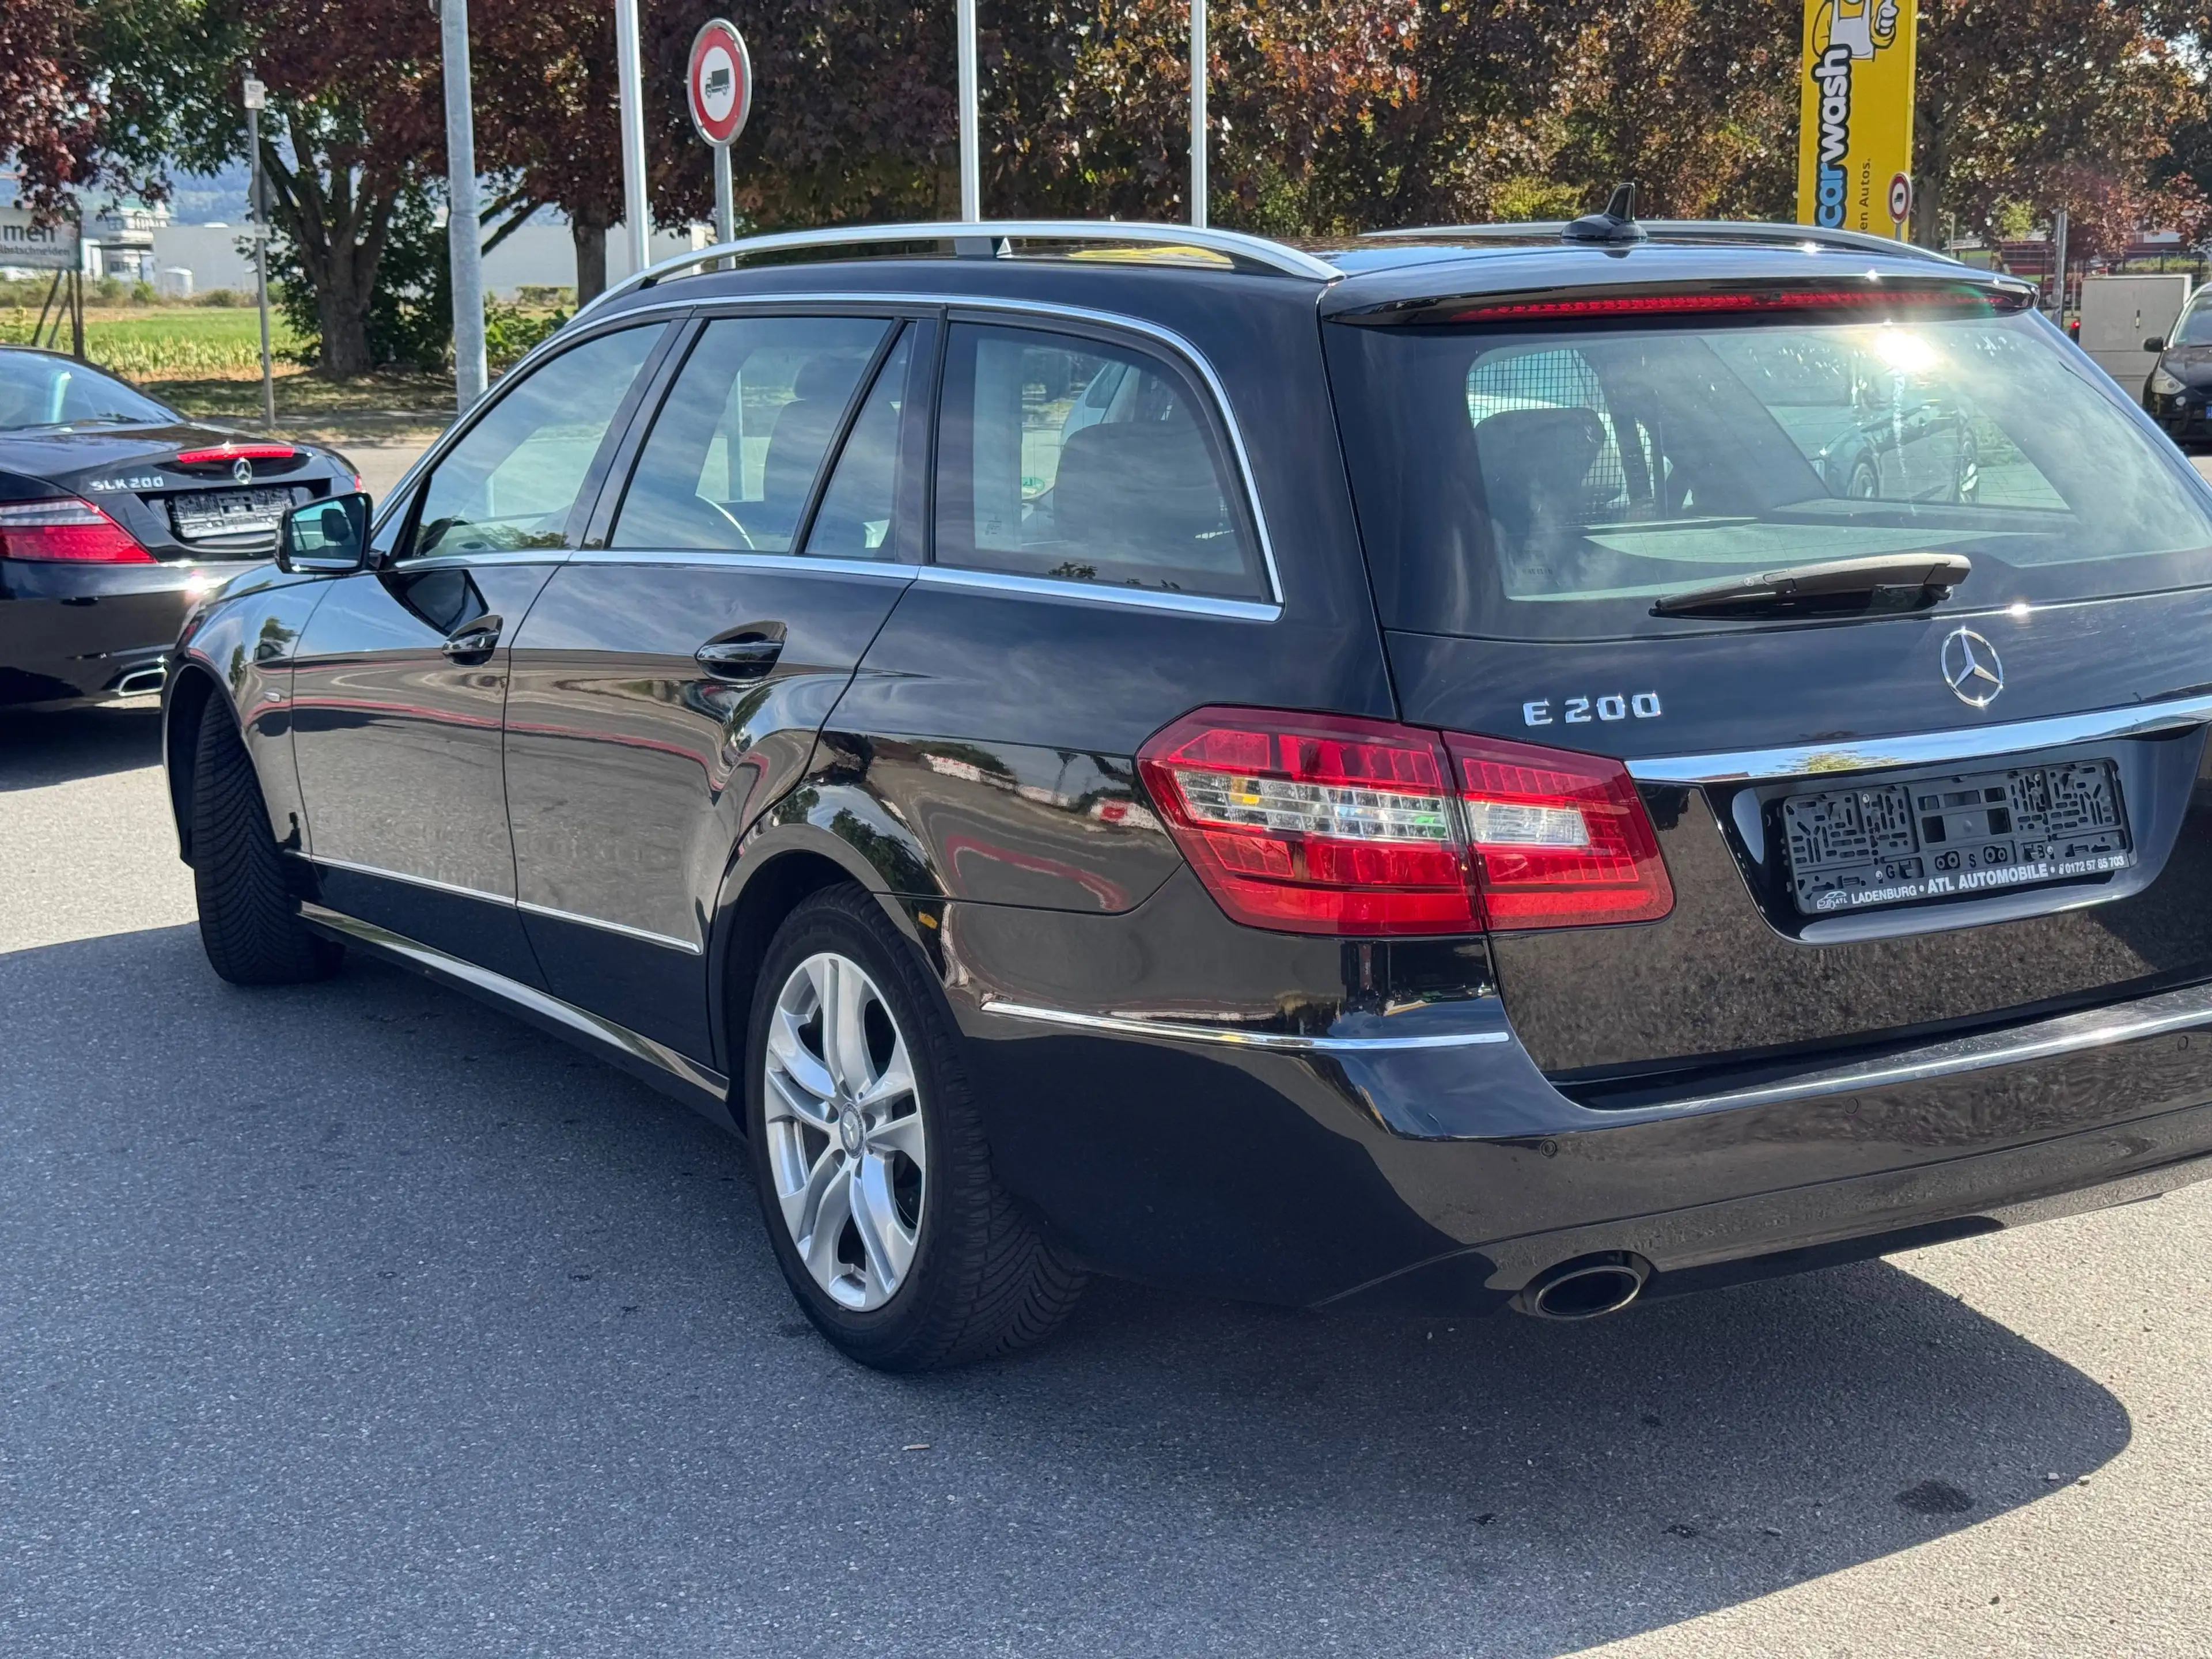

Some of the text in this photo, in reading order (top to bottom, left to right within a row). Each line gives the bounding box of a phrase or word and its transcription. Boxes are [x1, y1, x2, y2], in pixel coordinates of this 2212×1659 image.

[1815, 47, 1850, 228] carwash
[1859, 158, 1871, 232] en Autos.
[0, 225, 55, 243] men
[89, 475, 164, 491] SLK 200
[1522, 692, 1661, 726] E 200
[1851, 885, 1917, 904] LADENBURG
[1927, 876, 1955, 894] ATL
[1959, 863, 2049, 890] AUTOMOBILE
[2065, 861, 2085, 874] 0172
[2086, 859, 2096, 870] 57
[2109, 855, 2125, 868] 703
